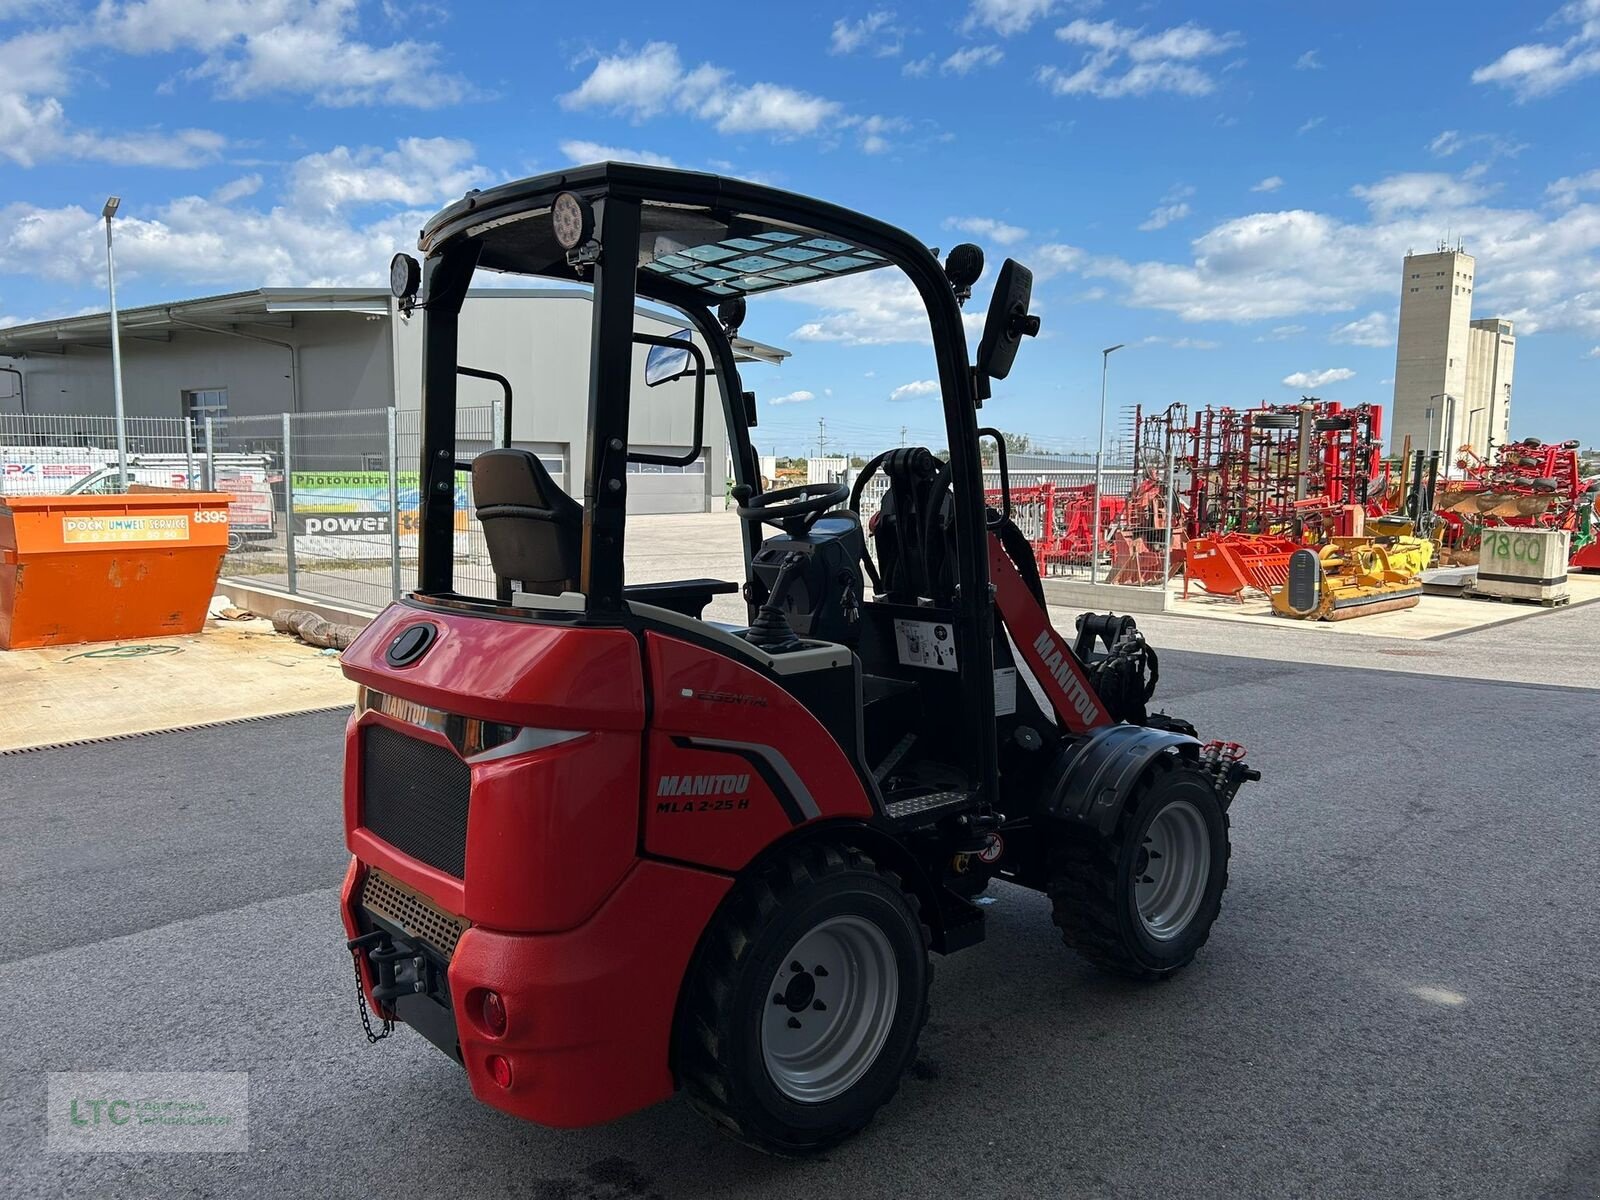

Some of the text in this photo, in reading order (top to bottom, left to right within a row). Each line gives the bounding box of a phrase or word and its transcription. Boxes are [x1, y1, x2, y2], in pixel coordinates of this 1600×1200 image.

[109, 519, 145, 530] UMWELT
[149, 518, 186, 530] SERVICE
[194, 511, 227, 524] 8395
[306, 516, 388, 536] power
[1483, 533, 1540, 563] 1800
[1033, 629, 1099, 725] MANITOU
[380, 694, 429, 726] MANITOU
[657, 774, 750, 796] MANITOU
[656, 799, 749, 813] MLA 2-25 H
